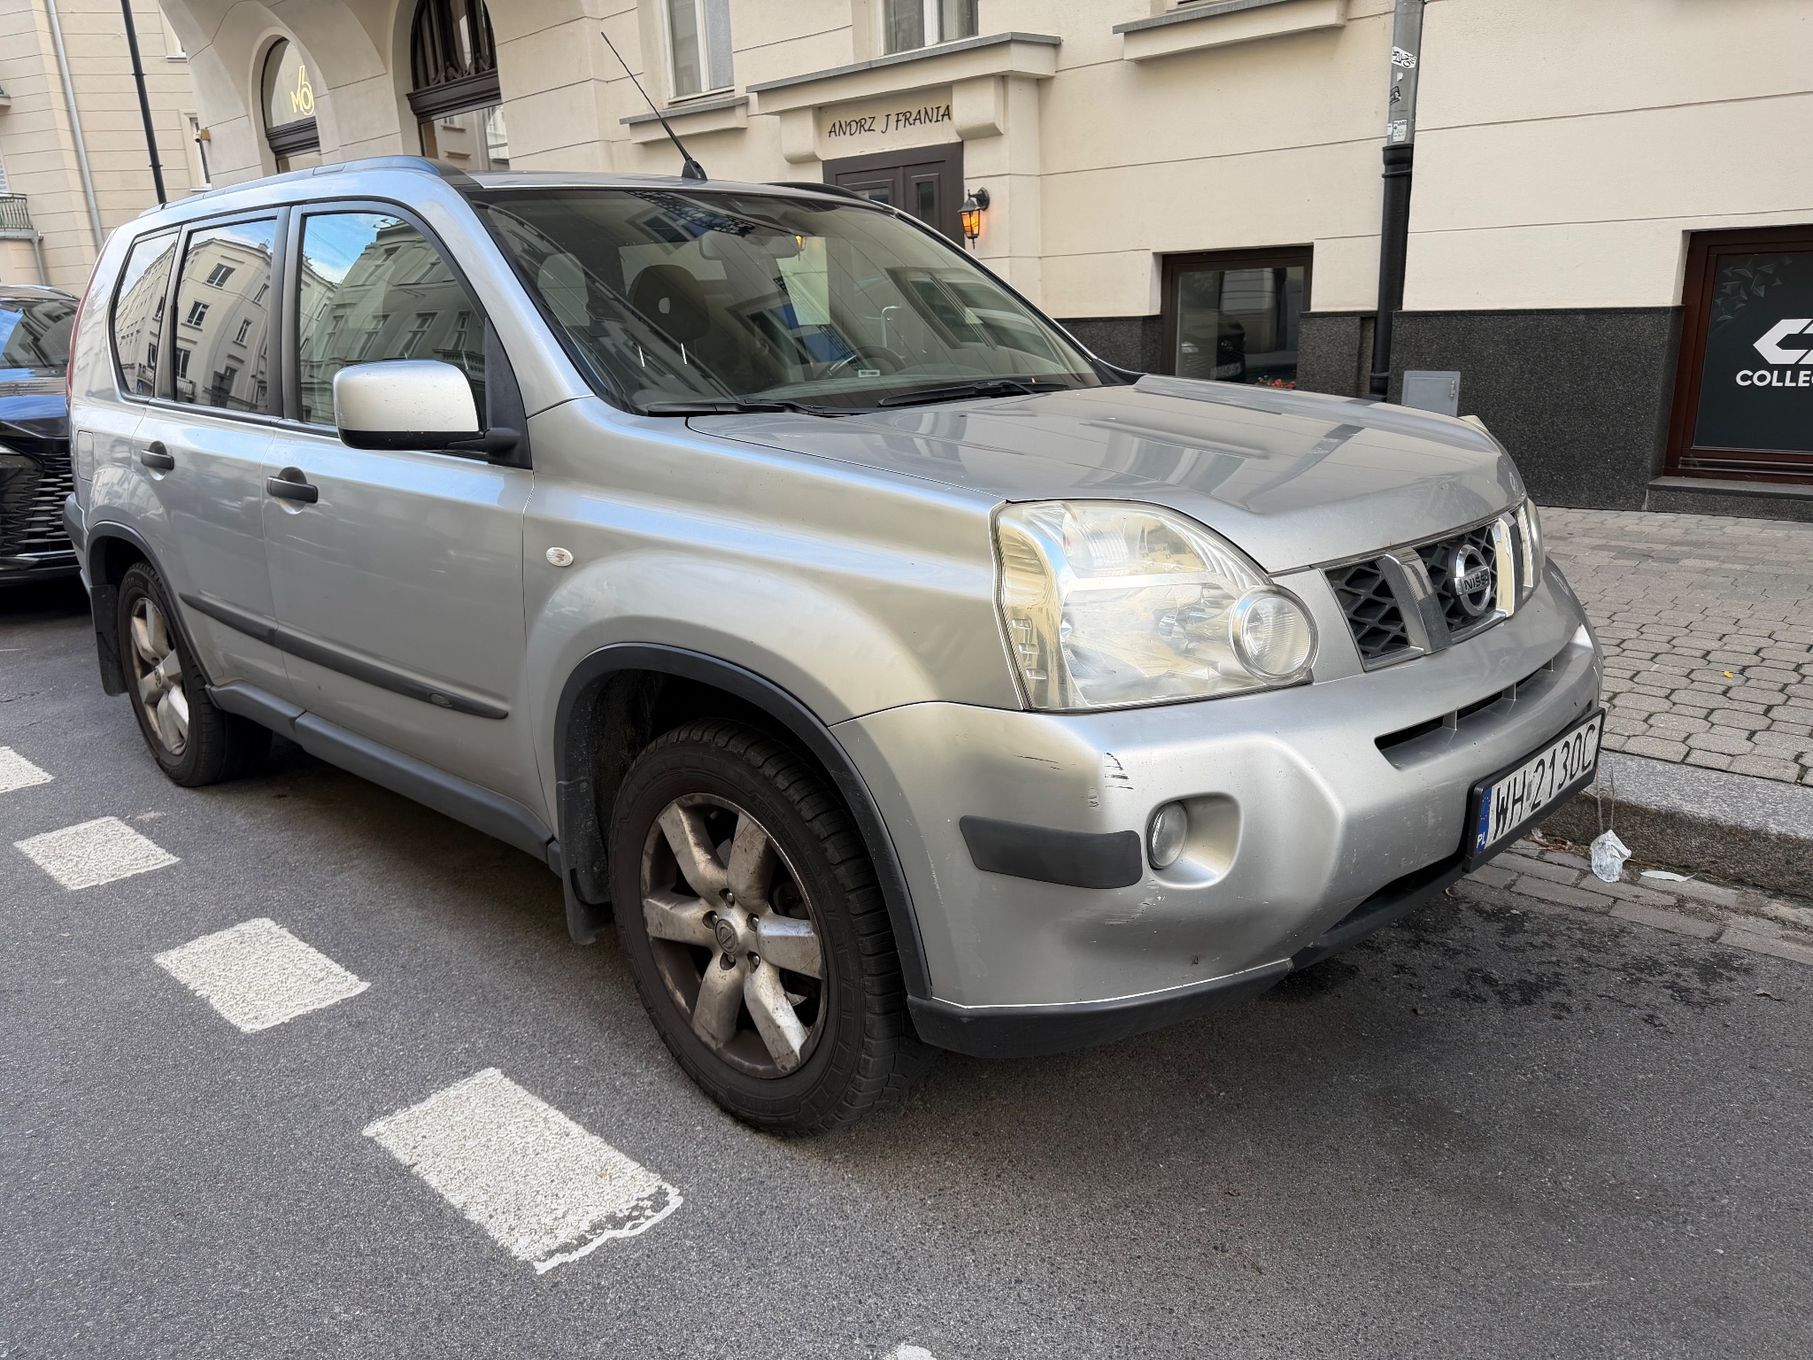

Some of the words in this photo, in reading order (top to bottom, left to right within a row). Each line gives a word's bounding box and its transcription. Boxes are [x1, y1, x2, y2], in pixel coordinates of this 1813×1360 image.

[828, 116, 875, 138] ANDRZ
[895, 104, 952, 131] FRANIA
[1735, 369, 1813, 387] COLLE
[1464, 572, 1489, 591] NISS
[1492, 770, 1527, 841] WH
[1530, 723, 1596, 813] 2130C
[1476, 833, 1487, 849] PL
